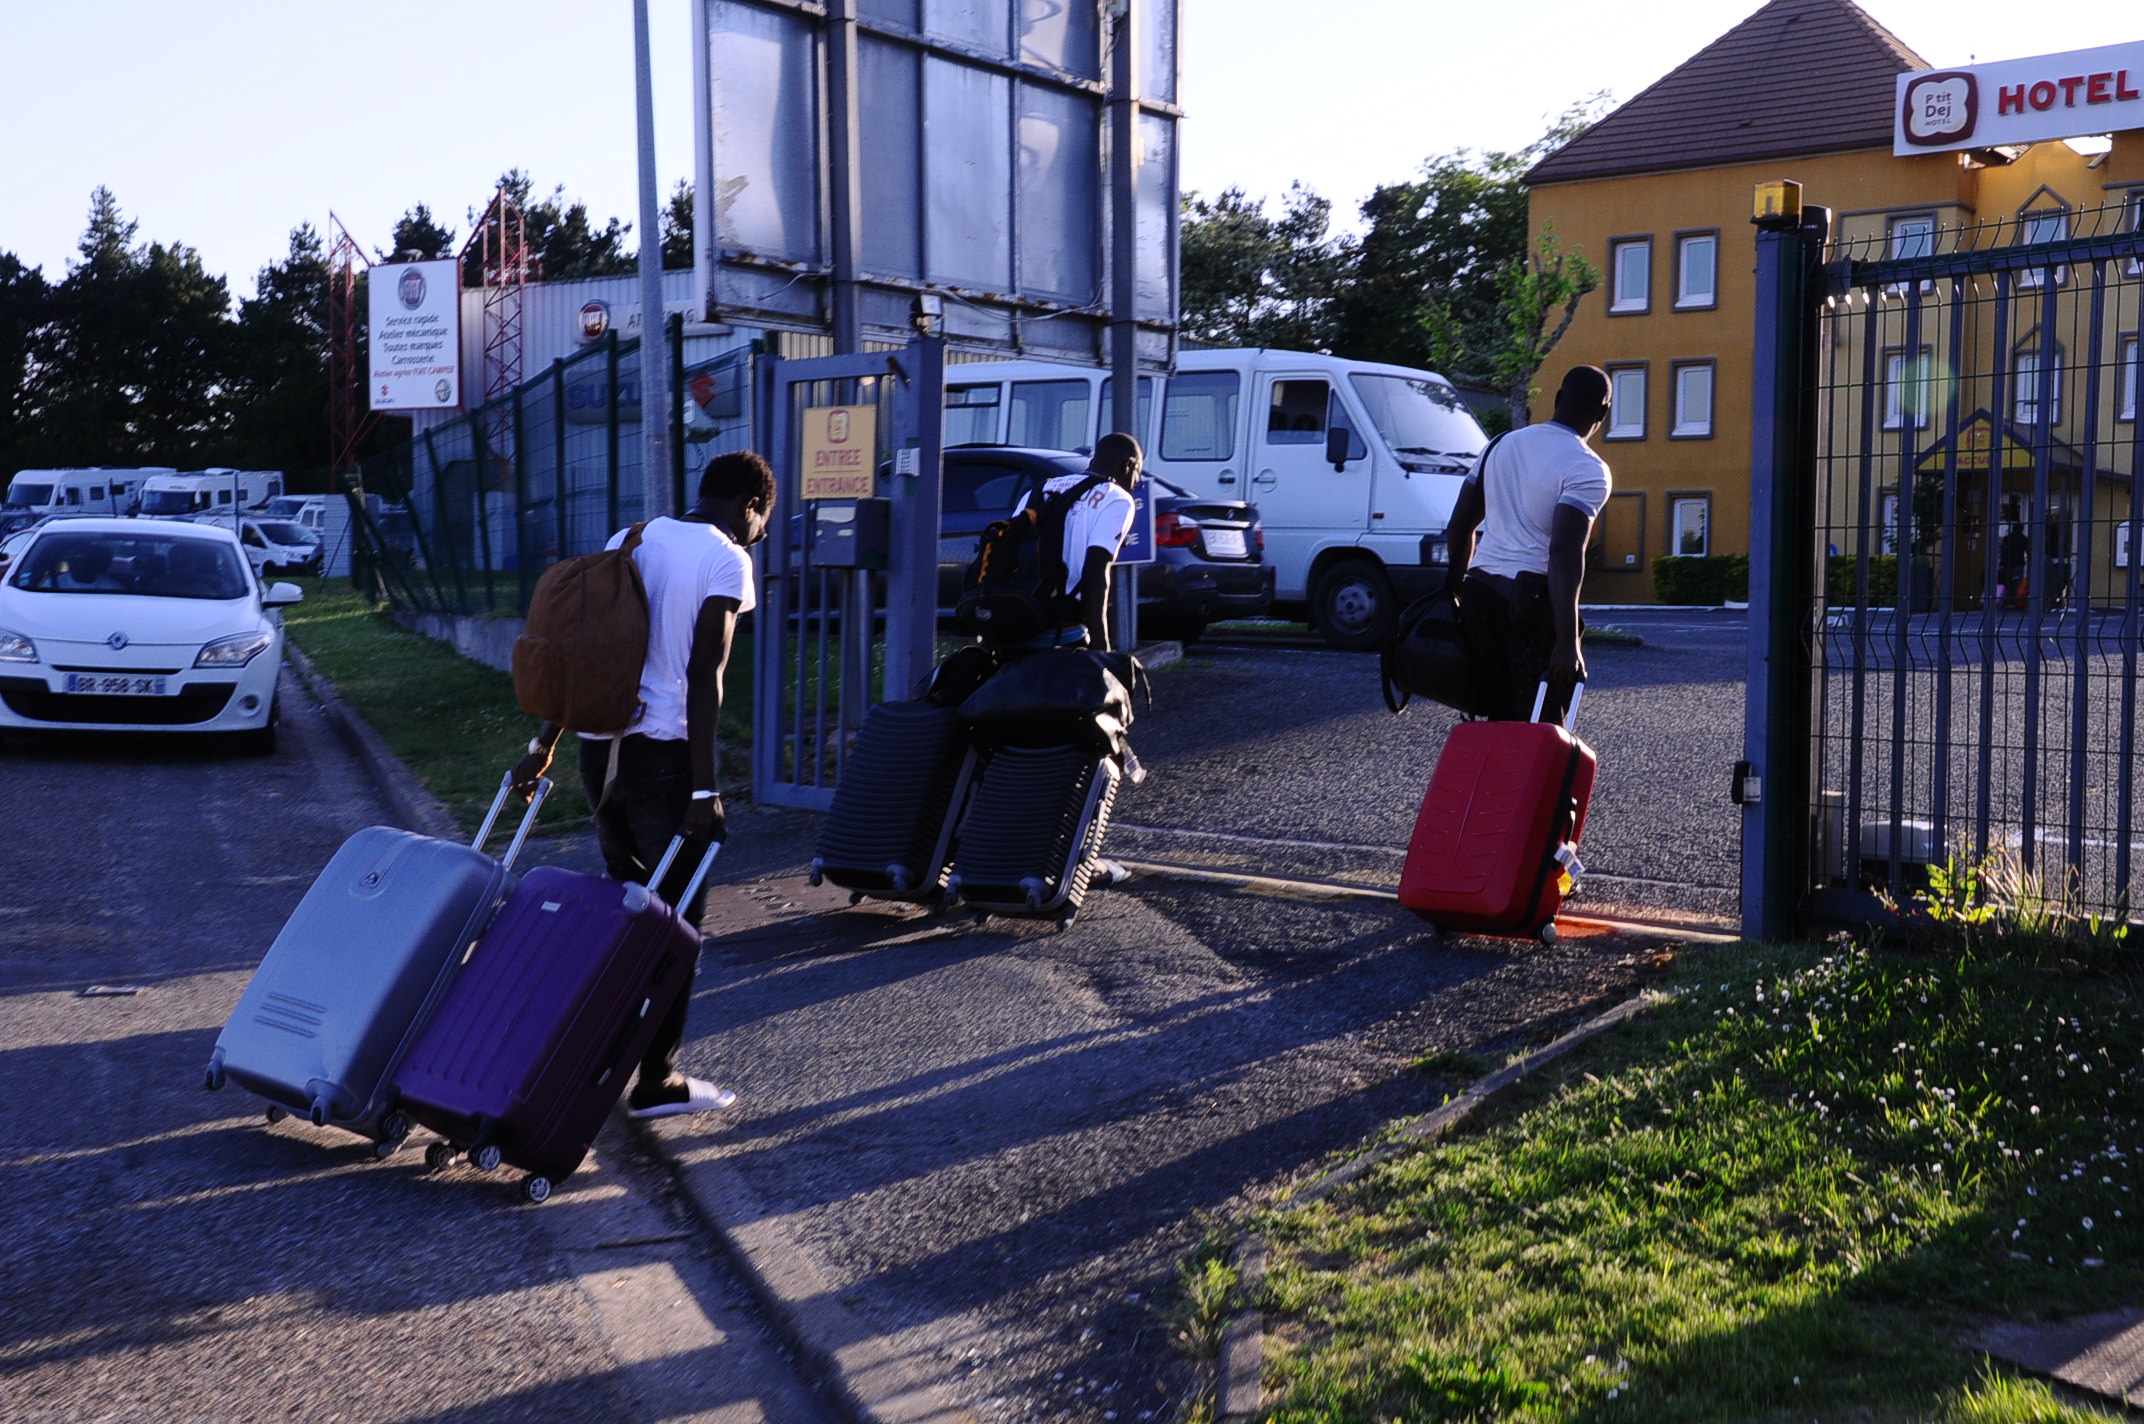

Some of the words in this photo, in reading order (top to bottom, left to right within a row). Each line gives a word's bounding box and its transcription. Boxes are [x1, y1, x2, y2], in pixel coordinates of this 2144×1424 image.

[1998, 70, 2140, 115] HOTEL
[815, 449, 862, 467] ENTREE
[806, 476, 869, 494] ENTRANCE
